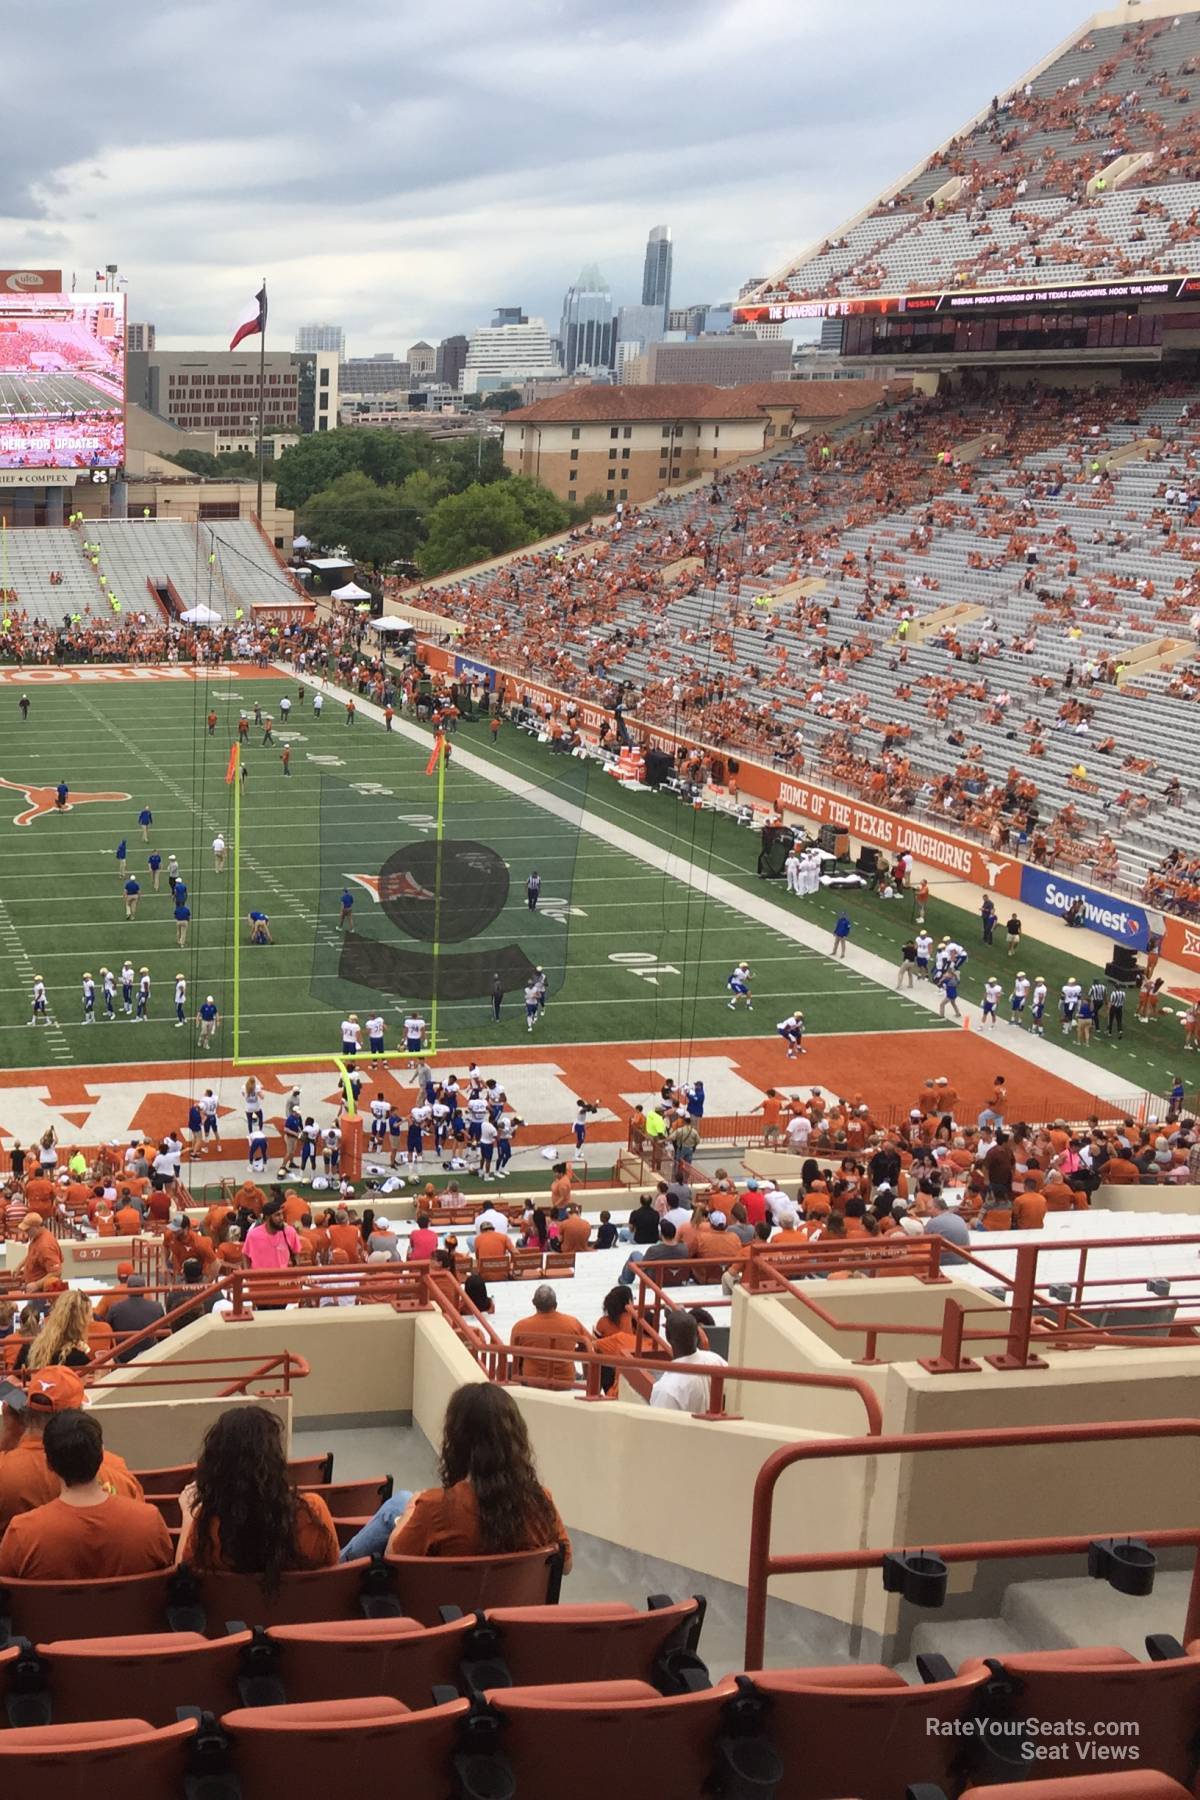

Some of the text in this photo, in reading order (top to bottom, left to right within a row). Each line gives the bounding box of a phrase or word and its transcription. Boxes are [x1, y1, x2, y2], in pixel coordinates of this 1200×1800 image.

[769, 307, 782, 319] THE
[784, 304, 826, 318] UNIVERSITY
[827, 303, 839, 315] OF
[1, 439, 28, 450] HERE
[31, 438, 50, 449] FOR
[25, 474, 68, 482] COMPLEX
[93, 471, 108, 483] 25
[779, 782, 972, 874] HOME OF THE TEXAS LONGHORNS
[608, 952, 681, 976] 10
